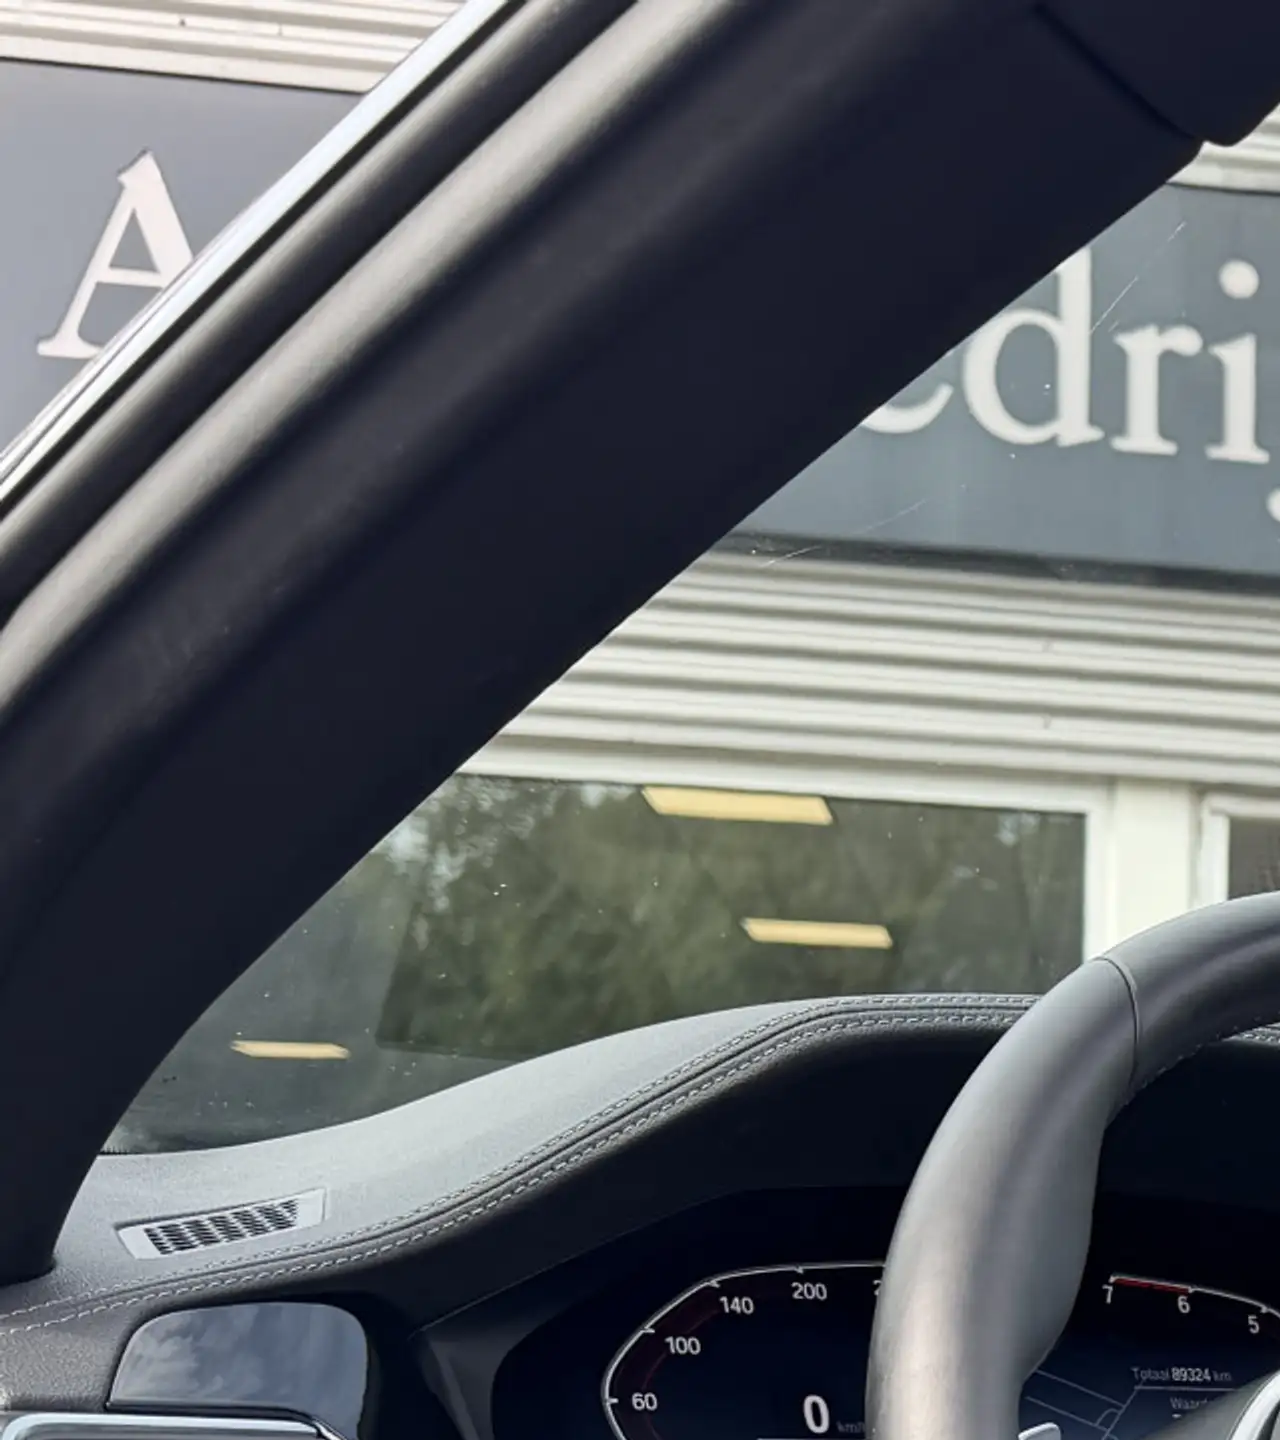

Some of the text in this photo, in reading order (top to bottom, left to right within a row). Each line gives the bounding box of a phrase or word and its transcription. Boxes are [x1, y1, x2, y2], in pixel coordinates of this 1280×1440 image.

[791, 1282, 828, 1300] 200
[1102, 1284, 1113, 1304] 7
[719, 1296, 754, 1315] 140
[1177, 1295, 1190, 1314] 6
[1248, 1314, 1260, 1334] 5
[664, 1336, 700, 1355] 100
[1171, 1367, 1212, 1382] 89324
[1213, 1370, 1232, 1382] km
[631, 1393, 658, 1411] 60
[802, 1395, 830, 1434] 0
